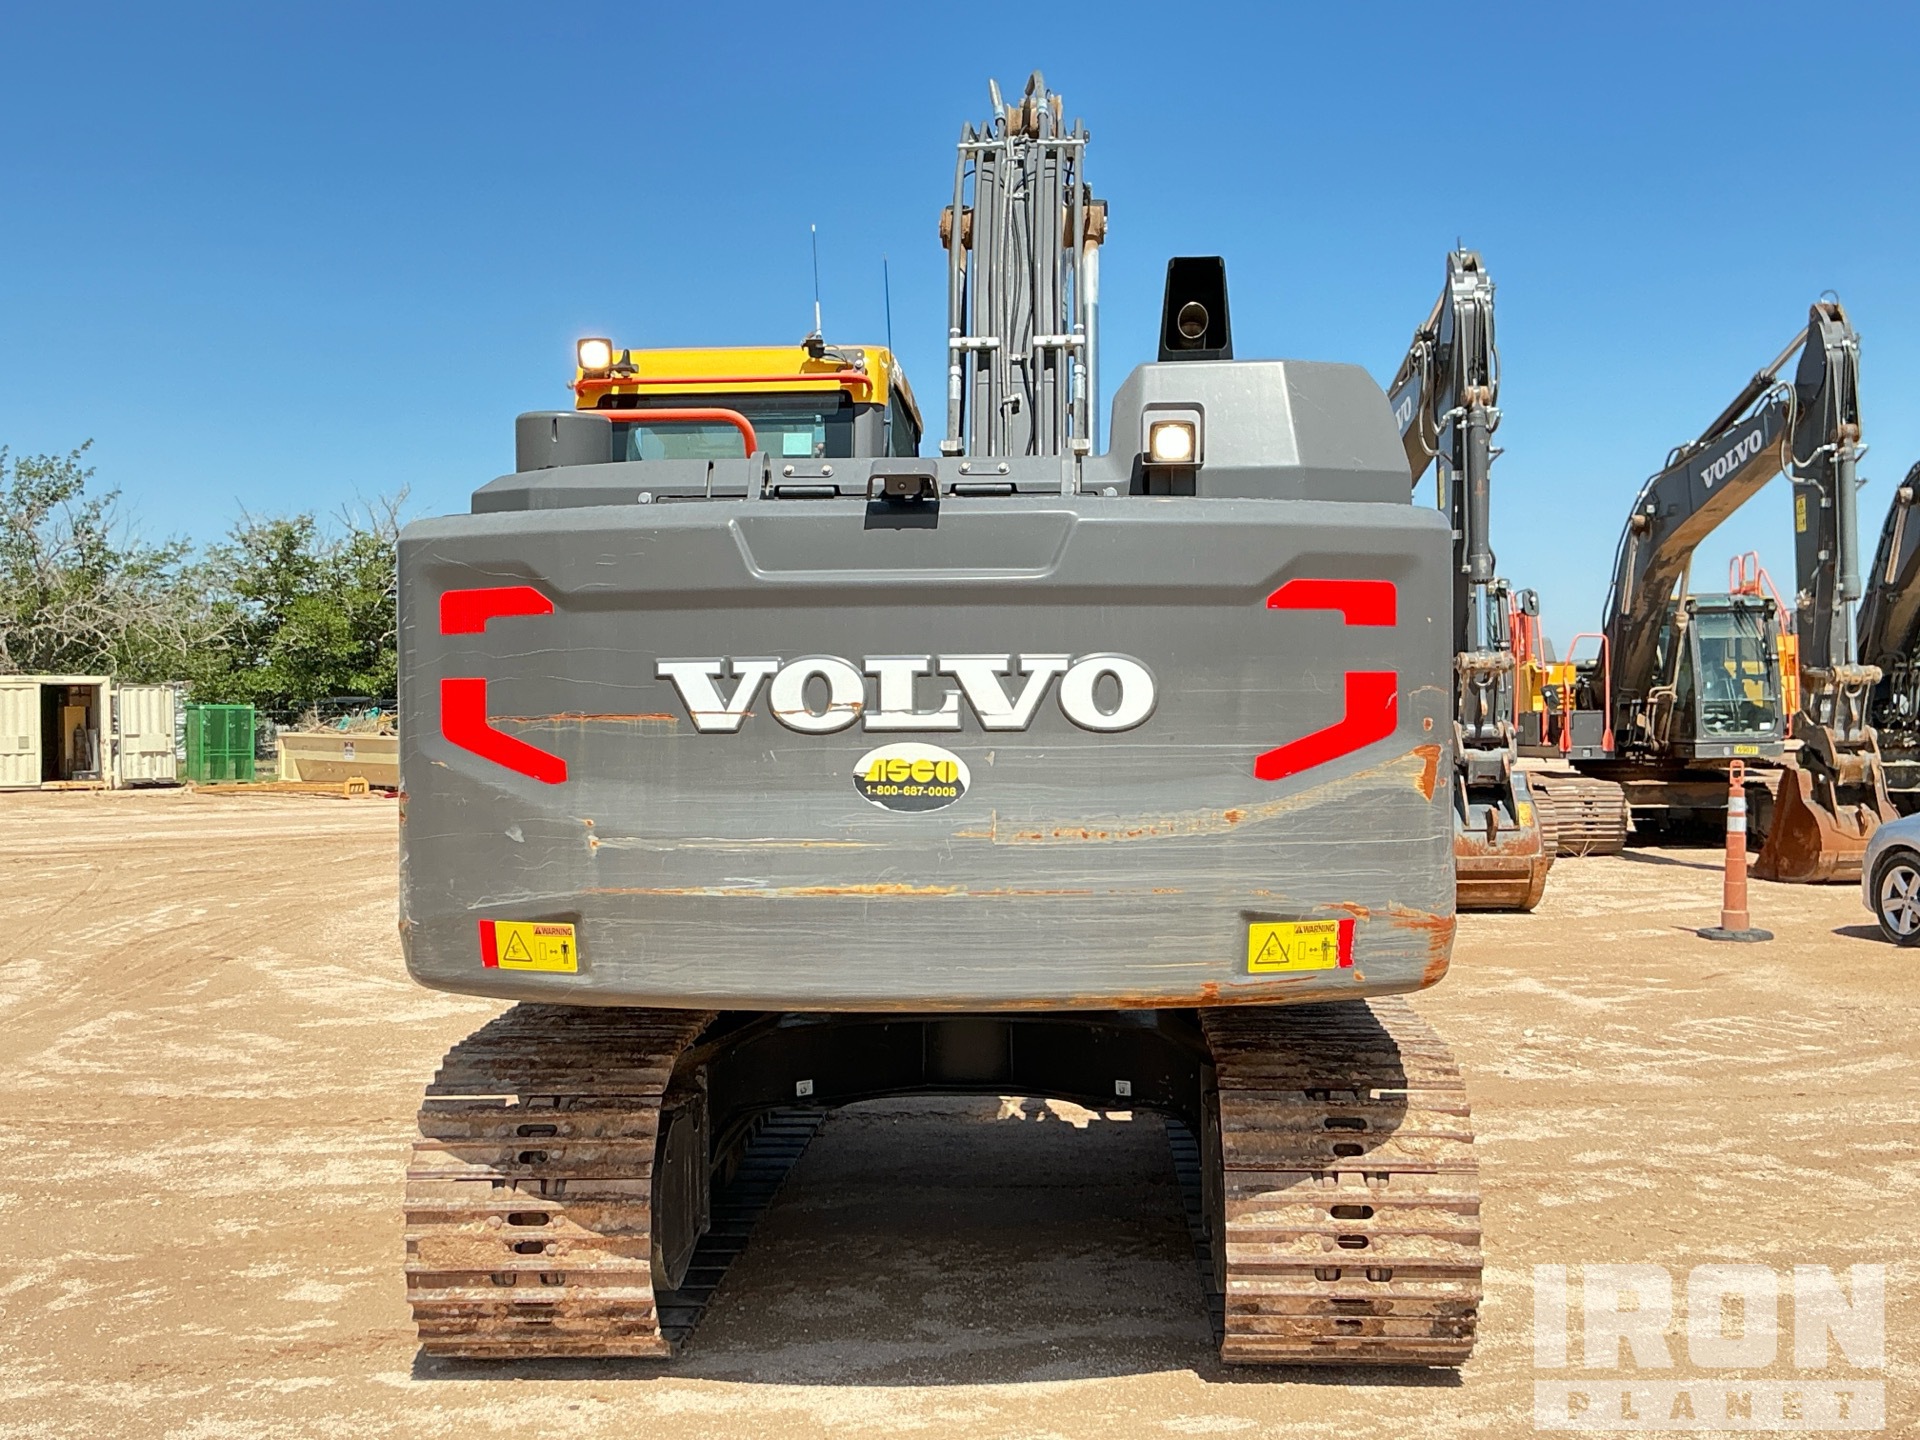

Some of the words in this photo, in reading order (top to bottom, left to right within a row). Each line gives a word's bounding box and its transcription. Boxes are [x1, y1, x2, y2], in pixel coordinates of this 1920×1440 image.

[1700, 429, 1763, 489] VOLVO
[655, 653, 1159, 734] VOLVO
[864, 758, 959, 783] ASCO
[866, 785, 957, 797] 1-800-687-0008
[542, 927, 572, 936] WARNING
[1304, 924, 1335, 933] WARNING
